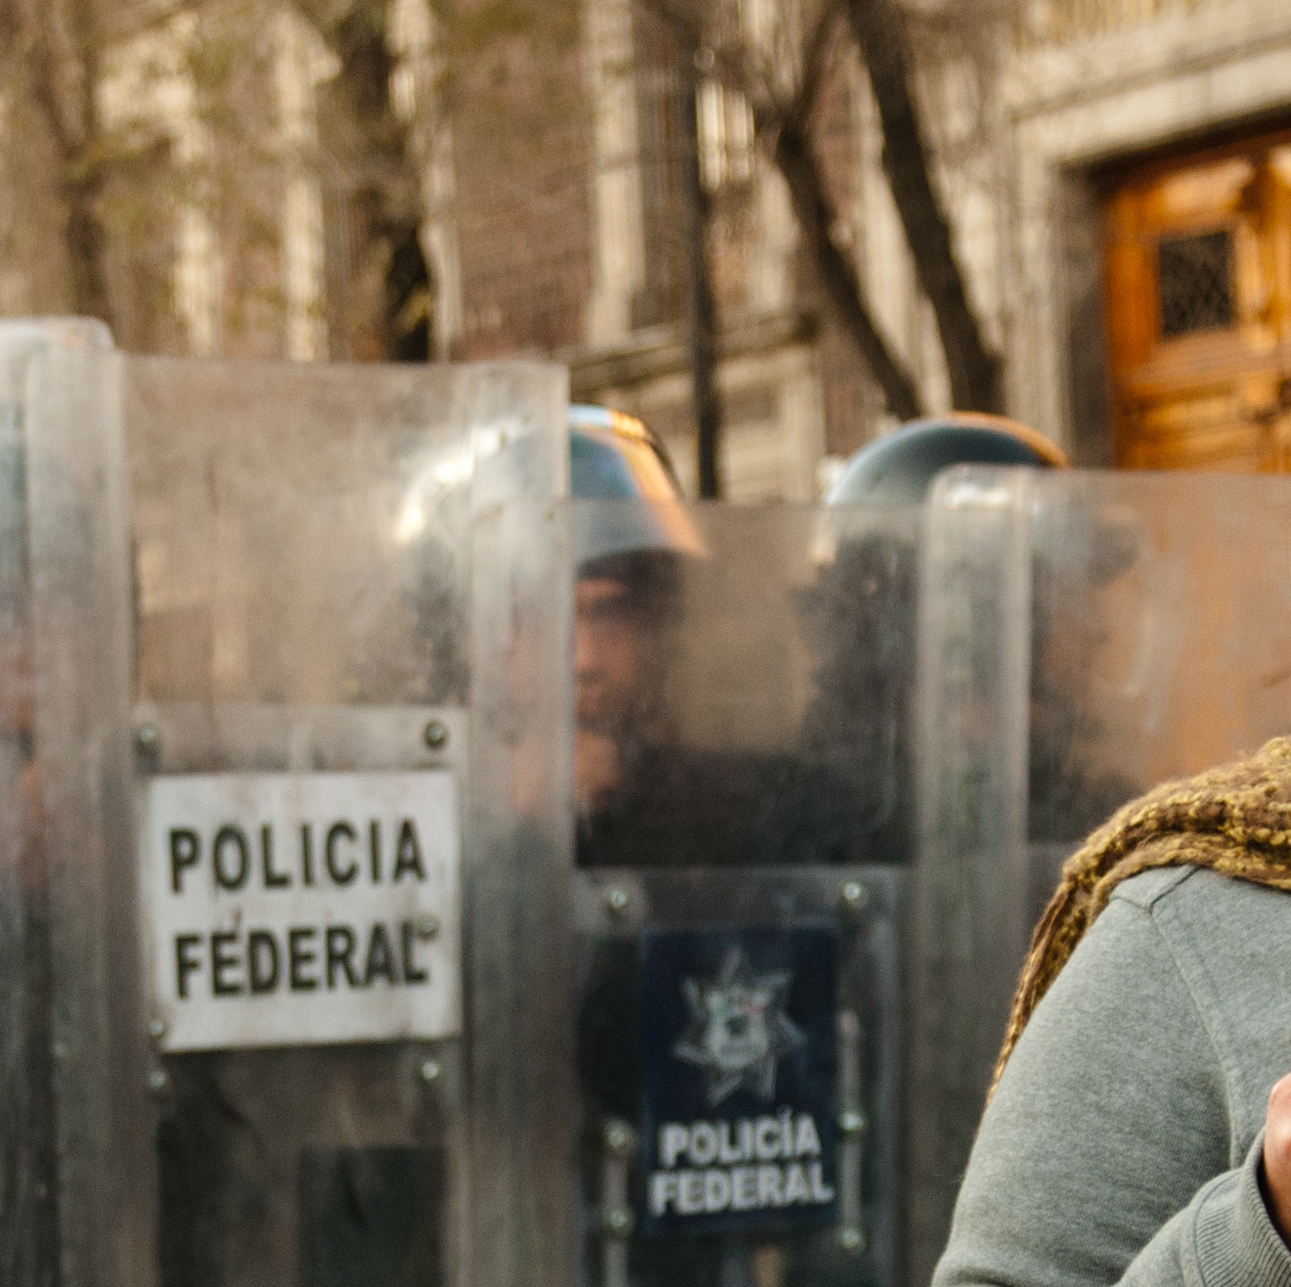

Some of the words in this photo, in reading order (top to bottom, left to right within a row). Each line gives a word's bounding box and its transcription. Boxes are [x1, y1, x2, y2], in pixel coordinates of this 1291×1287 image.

[167, 819, 427, 894] POLICIA
[174, 922, 428, 999] FEDERAL
[660, 1106, 821, 1167] POLICÍA
[648, 1160, 835, 1217] FEDERAL
